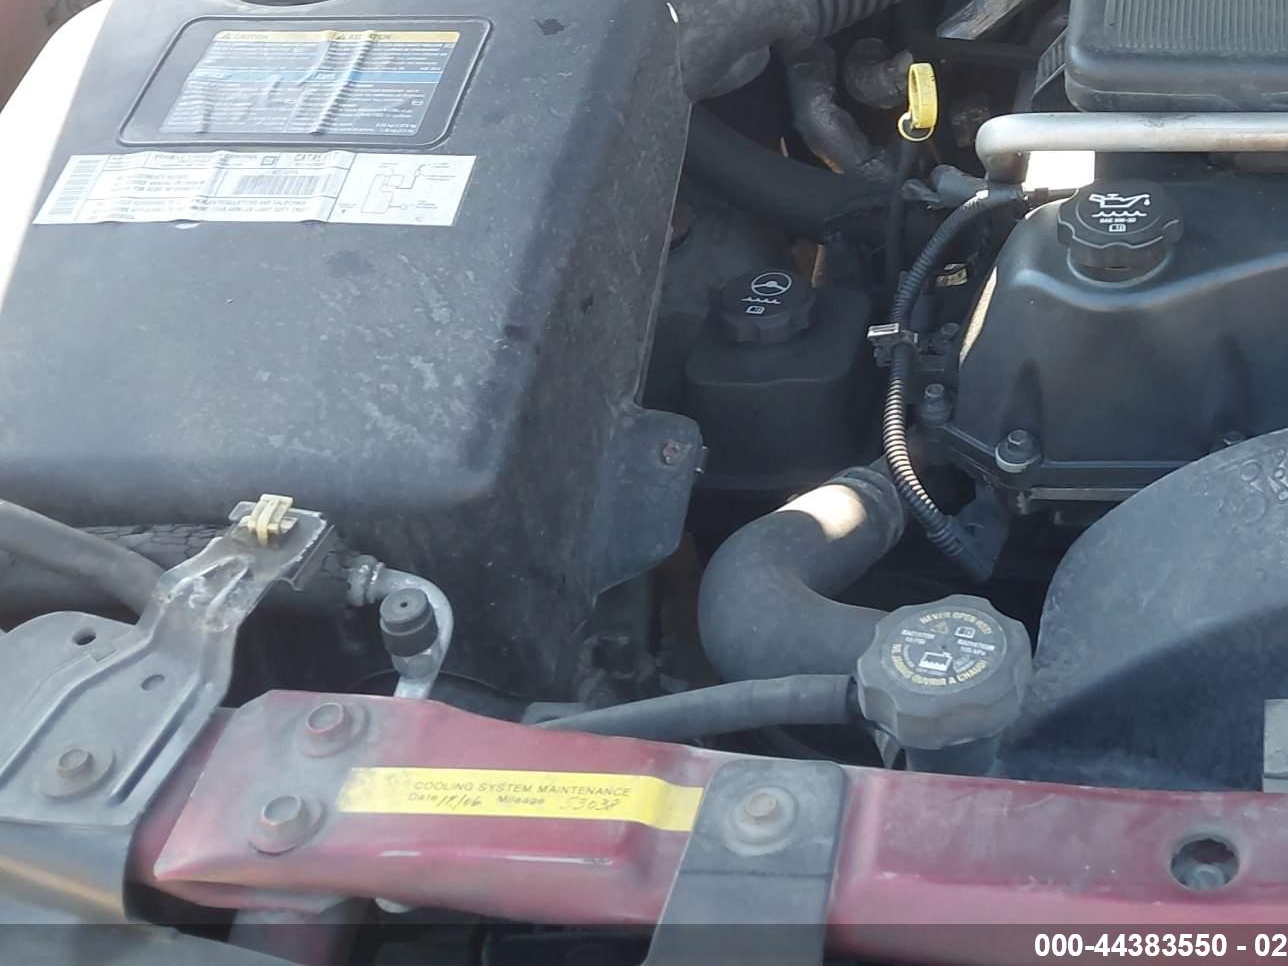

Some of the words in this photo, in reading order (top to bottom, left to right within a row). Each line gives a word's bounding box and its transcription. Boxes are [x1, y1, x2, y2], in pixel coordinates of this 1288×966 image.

[920, 611, 952, 624] NEVER
[952, 611, 976, 624] OPEN
[414, 781, 474, 792] COOLING
[478, 782, 533, 794] SYSTEM
[538, 785, 632, 797] MAINTENANCE
[408, 792, 439, 802] Date
[498, 794, 546, 805] Mileage
